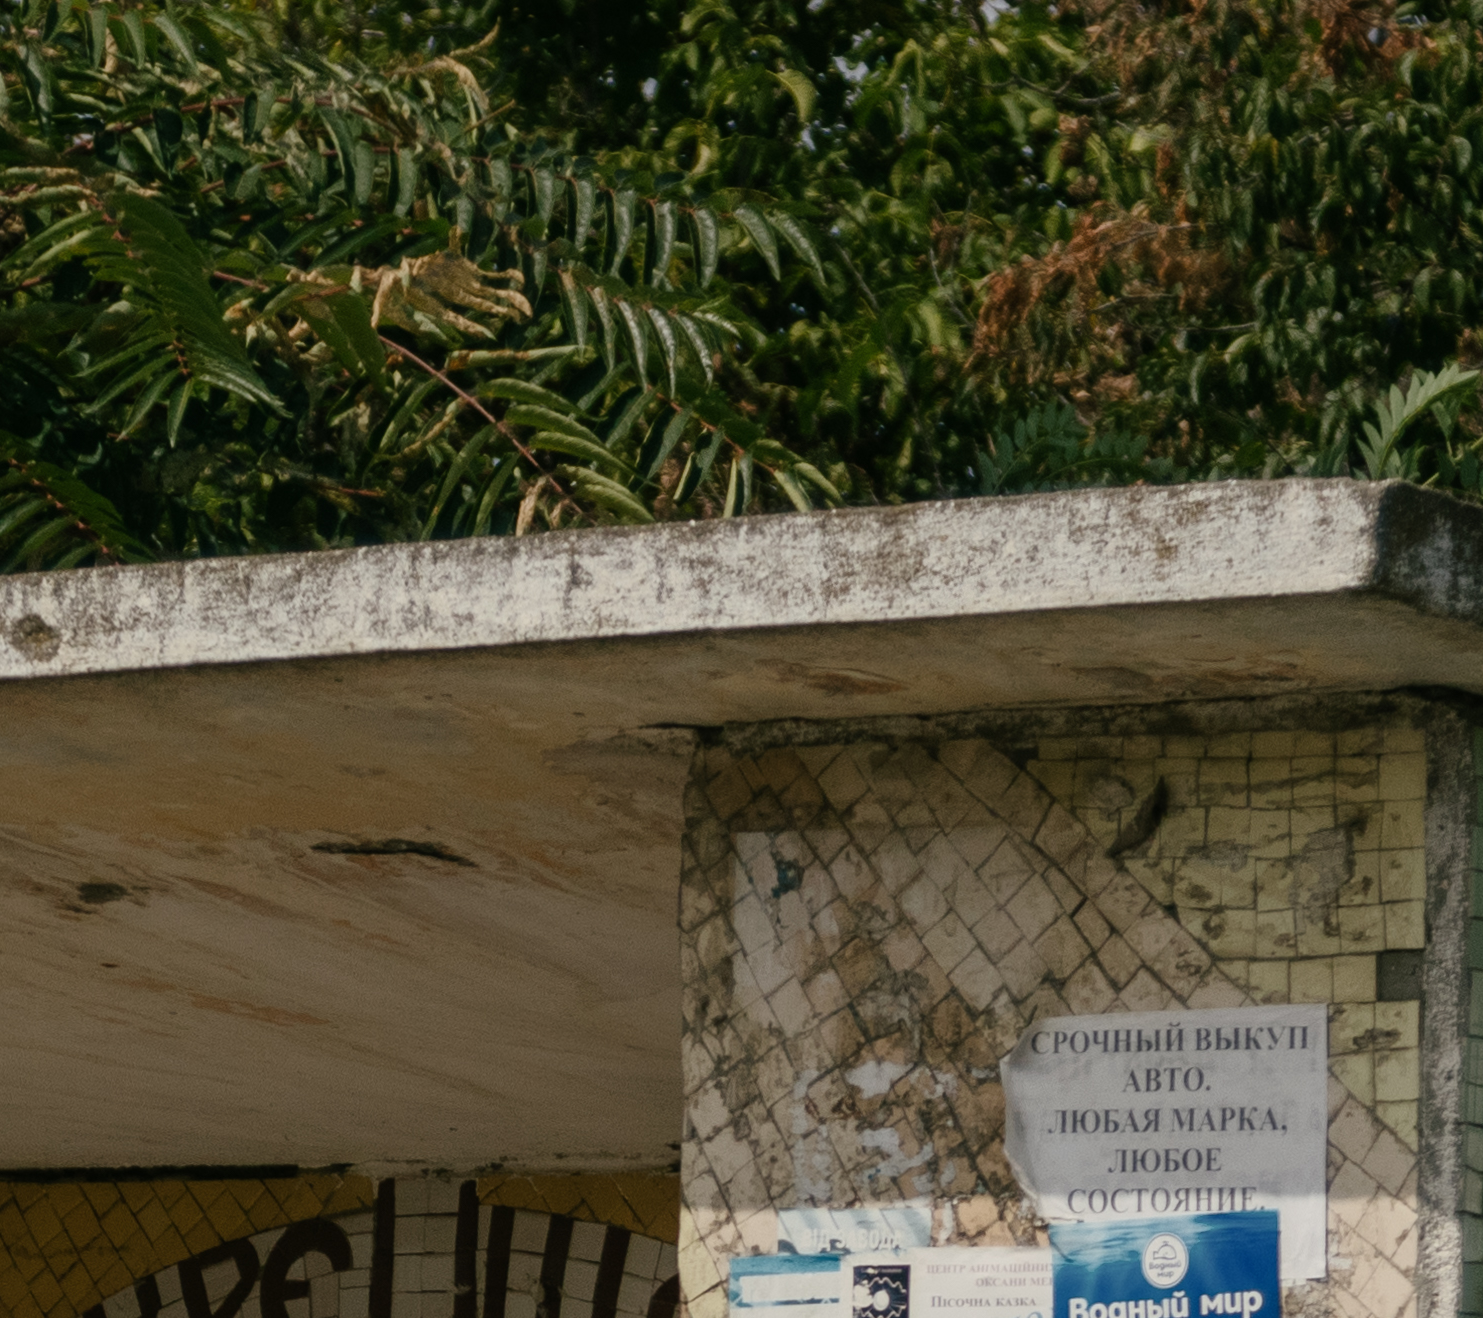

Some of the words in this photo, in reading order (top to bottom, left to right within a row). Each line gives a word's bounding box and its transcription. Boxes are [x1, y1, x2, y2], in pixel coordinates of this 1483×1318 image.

[1030, 1022, 1184, 1054] СРОЧНЫЙ
[1196, 1025, 1309, 1052] ВЫКУП
[1122, 1066, 1211, 1092] АВТО.
[1047, 1108, 1160, 1135] ЛЮБАЯ
[1171, 1106, 1288, 1135] МАРКА,
[1107, 1147, 1223, 1173] ЛЮБОЕ
[1067, 1186, 1265, 1215] СОСТОЯНИЕ.
